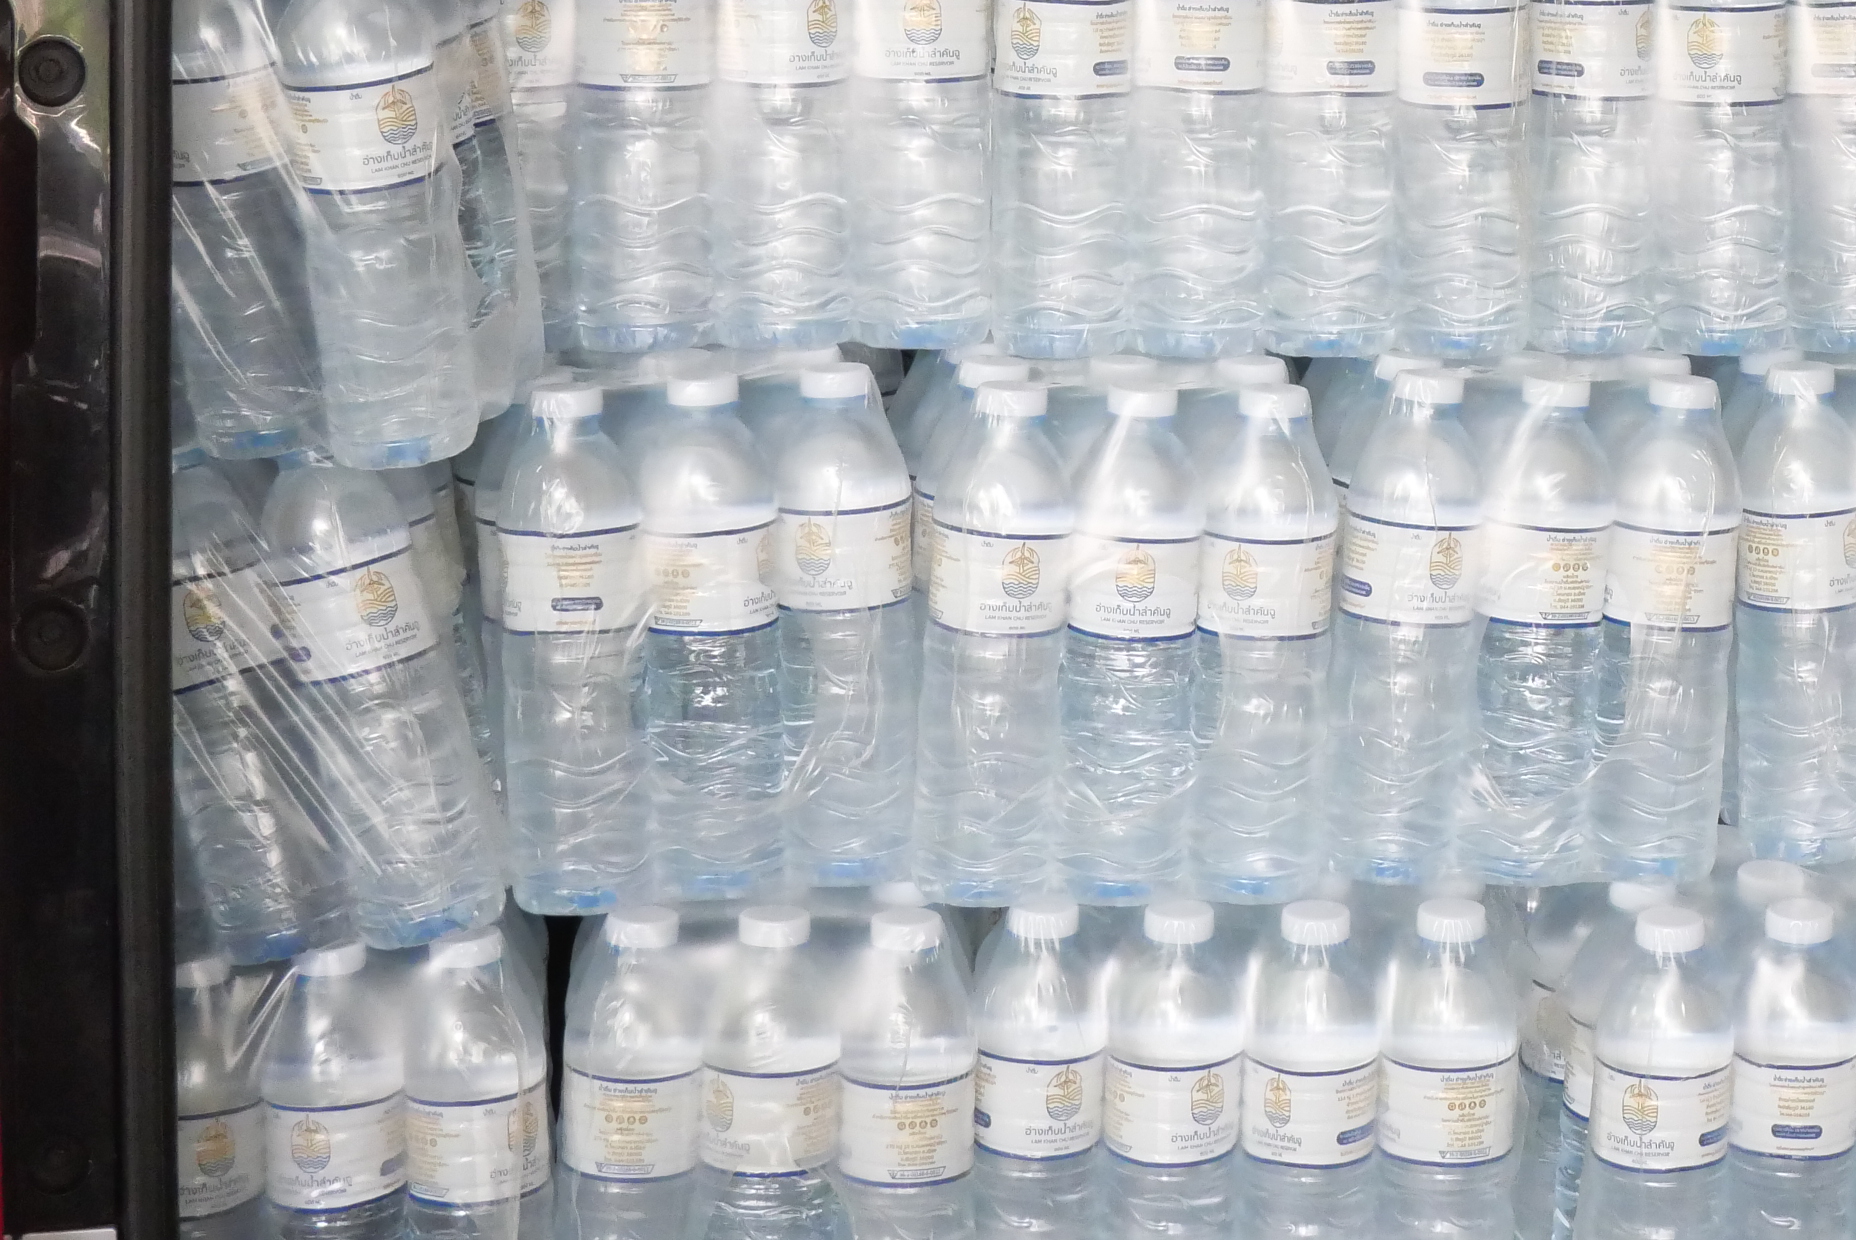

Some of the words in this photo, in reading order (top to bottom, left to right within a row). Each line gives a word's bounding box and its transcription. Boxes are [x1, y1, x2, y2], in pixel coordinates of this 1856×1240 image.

[885, 47, 960, 60] อ่างเก็บน้ำลำคันฉู
[1095, 603, 1171, 619] อ่างเก็บน้ำลำคันฉู
[1606, 1131, 1675, 1152] อ่างเก็บน้ำลำคันฉู
